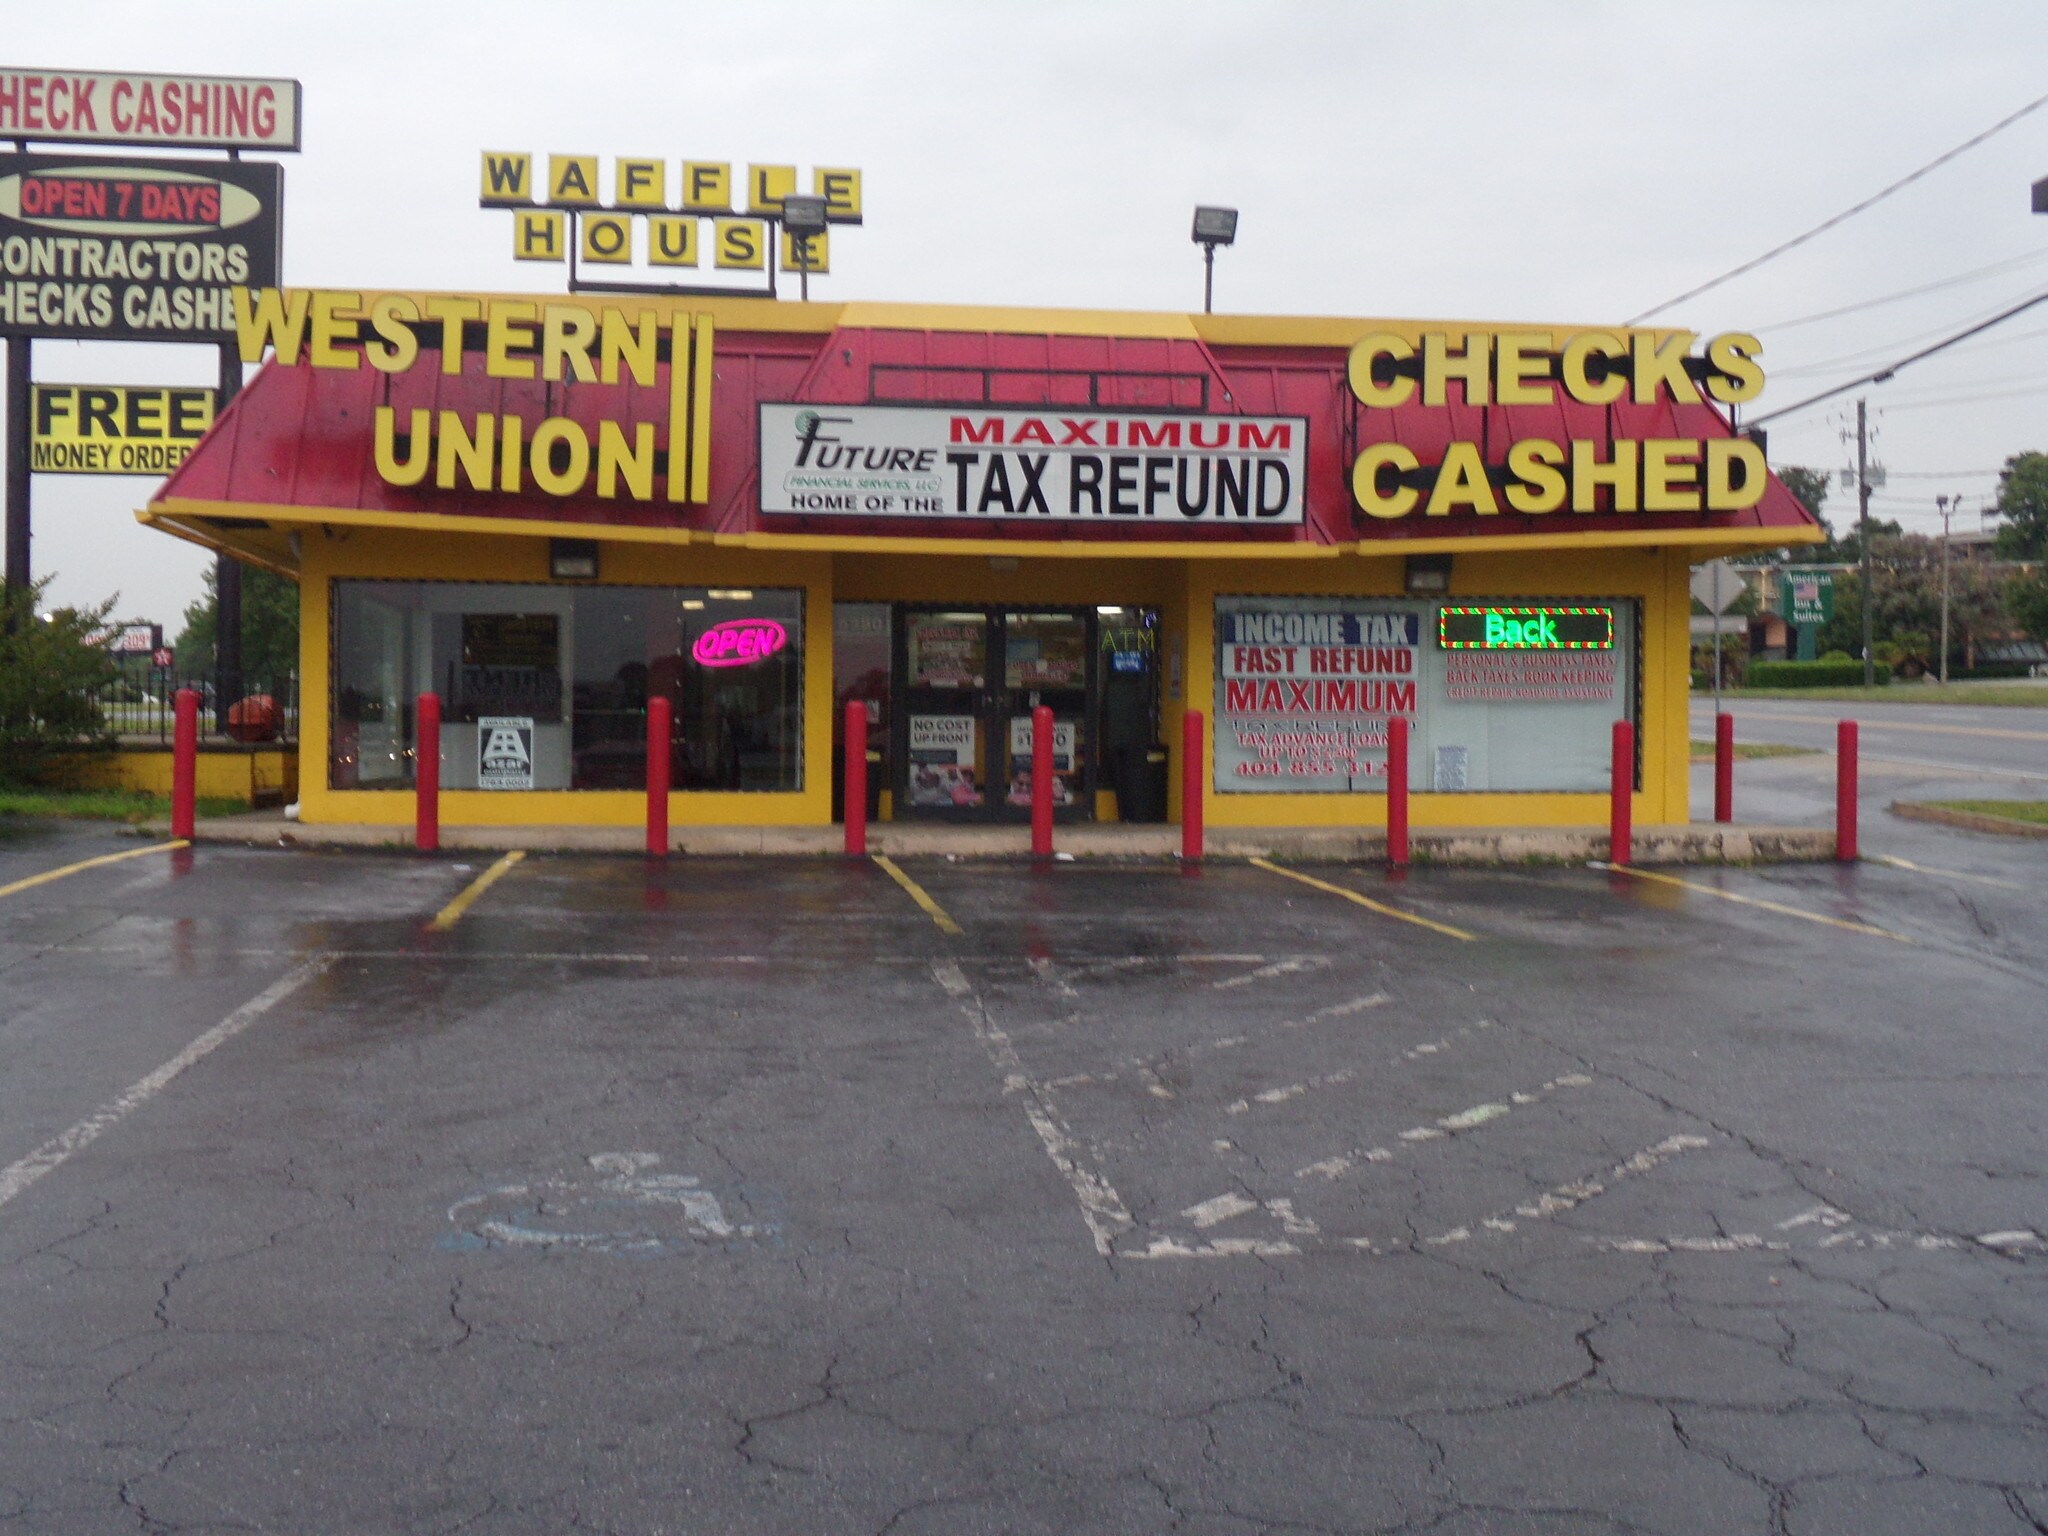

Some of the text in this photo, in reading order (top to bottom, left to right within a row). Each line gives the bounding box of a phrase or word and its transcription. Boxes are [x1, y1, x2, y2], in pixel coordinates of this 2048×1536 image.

[110, 79, 276, 138] CASHING
[21, 178, 220, 223] OPEN 7 DAYS
[487, 157, 852, 209] WAFFLE
[0, 236, 249, 283] ONTRACTORS
[524, 218, 819, 265] HOUSE
[123, 285, 259, 331] CASHE
[231, 285, 657, 387] WESTERN
[1346, 331, 1766, 408] CHECKS
[37, 389, 205, 438] FREE
[950, 417, 1291, 449] MAXIMUM
[34, 442, 112, 467] MONEY
[374, 406, 656, 500] UNION
[794, 416, 938, 471] FUTURE
[790, 475, 852, 489] FINANCIAL
[947, 453, 1290, 517] TAX REFUND
[1352, 437, 1768, 518] CASHED
[791, 493, 943, 512] HOME OF THE
[699, 628, 775, 658] OPEN
[1102, 628, 1155, 652] ATM
[1234, 613, 1408, 644] INCOME TAX
[1486, 613, 1557, 643] Back
[1234, 646, 1412, 673] FAST REFUND
[1225, 679, 1416, 713] MAXIMUM
[914, 719, 969, 732] NO COST
[1235, 731, 1267, 746] TAX
